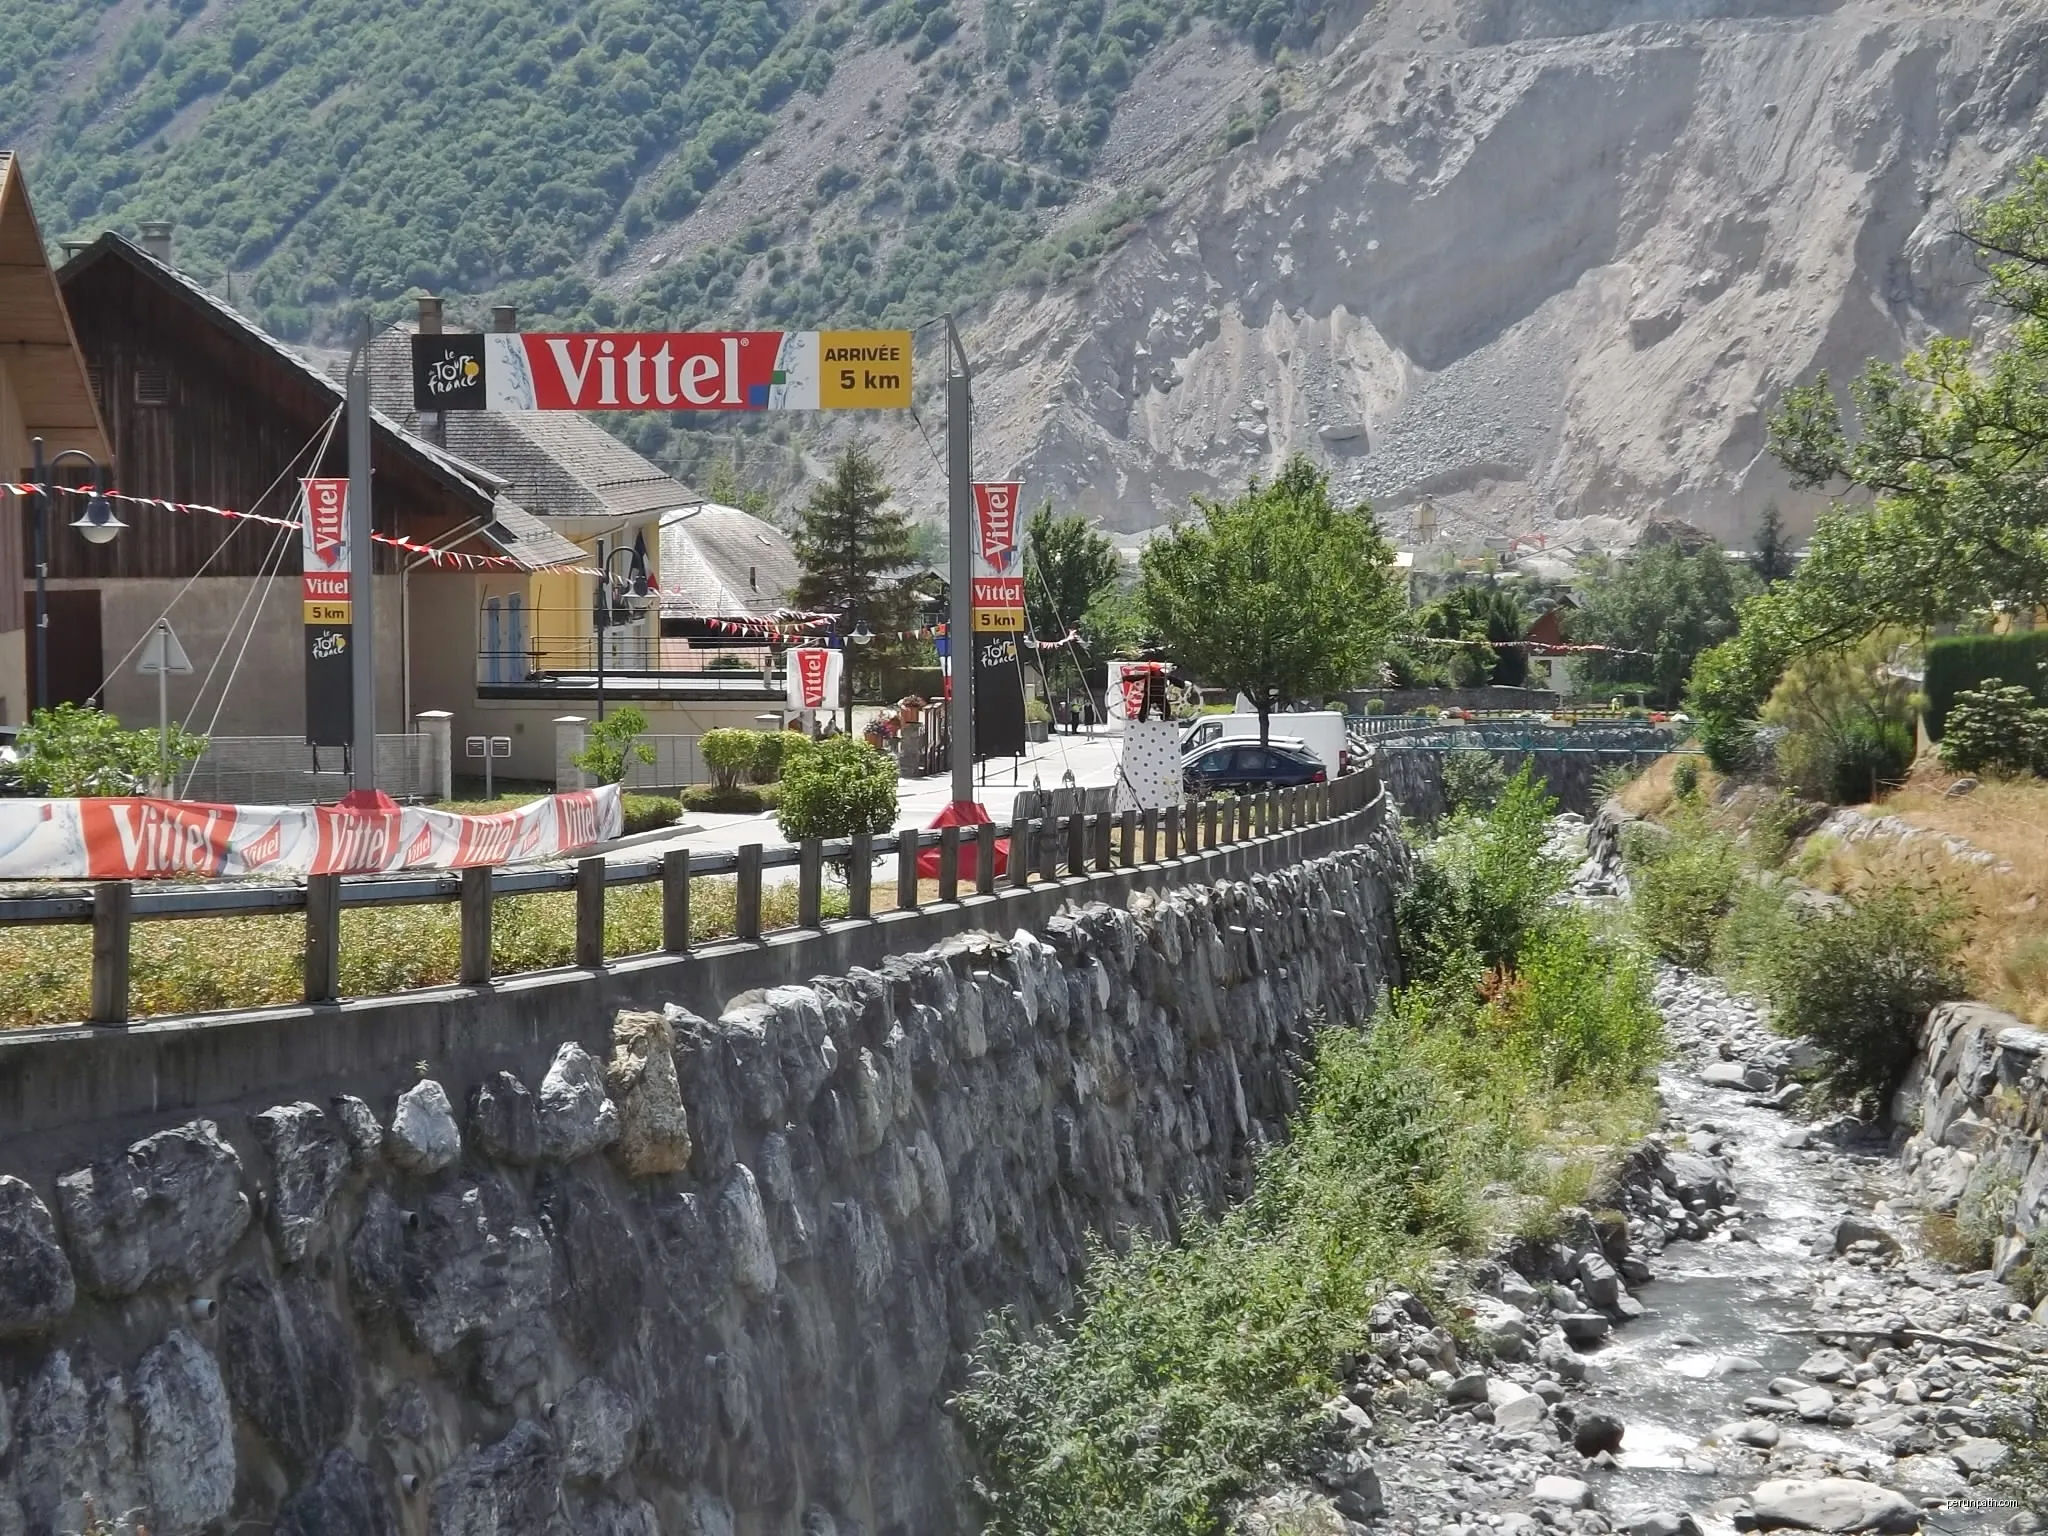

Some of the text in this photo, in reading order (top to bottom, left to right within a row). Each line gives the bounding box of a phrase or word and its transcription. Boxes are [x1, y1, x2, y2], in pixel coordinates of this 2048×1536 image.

[825, 345, 900, 362] ARRIVÉE
[840, 370, 900, 389] 5 km
[315, 482, 338, 552] Vittel
[985, 485, 1008, 557] Vittel
[306, 579, 349, 594] Vittel
[975, 584, 1021, 600] Vittel
[312, 607, 345, 619] 5 km
[981, 613, 1016, 626] 5 km
[804, 654, 822, 705] Vittel
[563, 796, 598, 846] Vittel
[108, 804, 218, 872] Vittel
[243, 831, 279, 864] Vittel
[328, 813, 391, 875] Vittel
